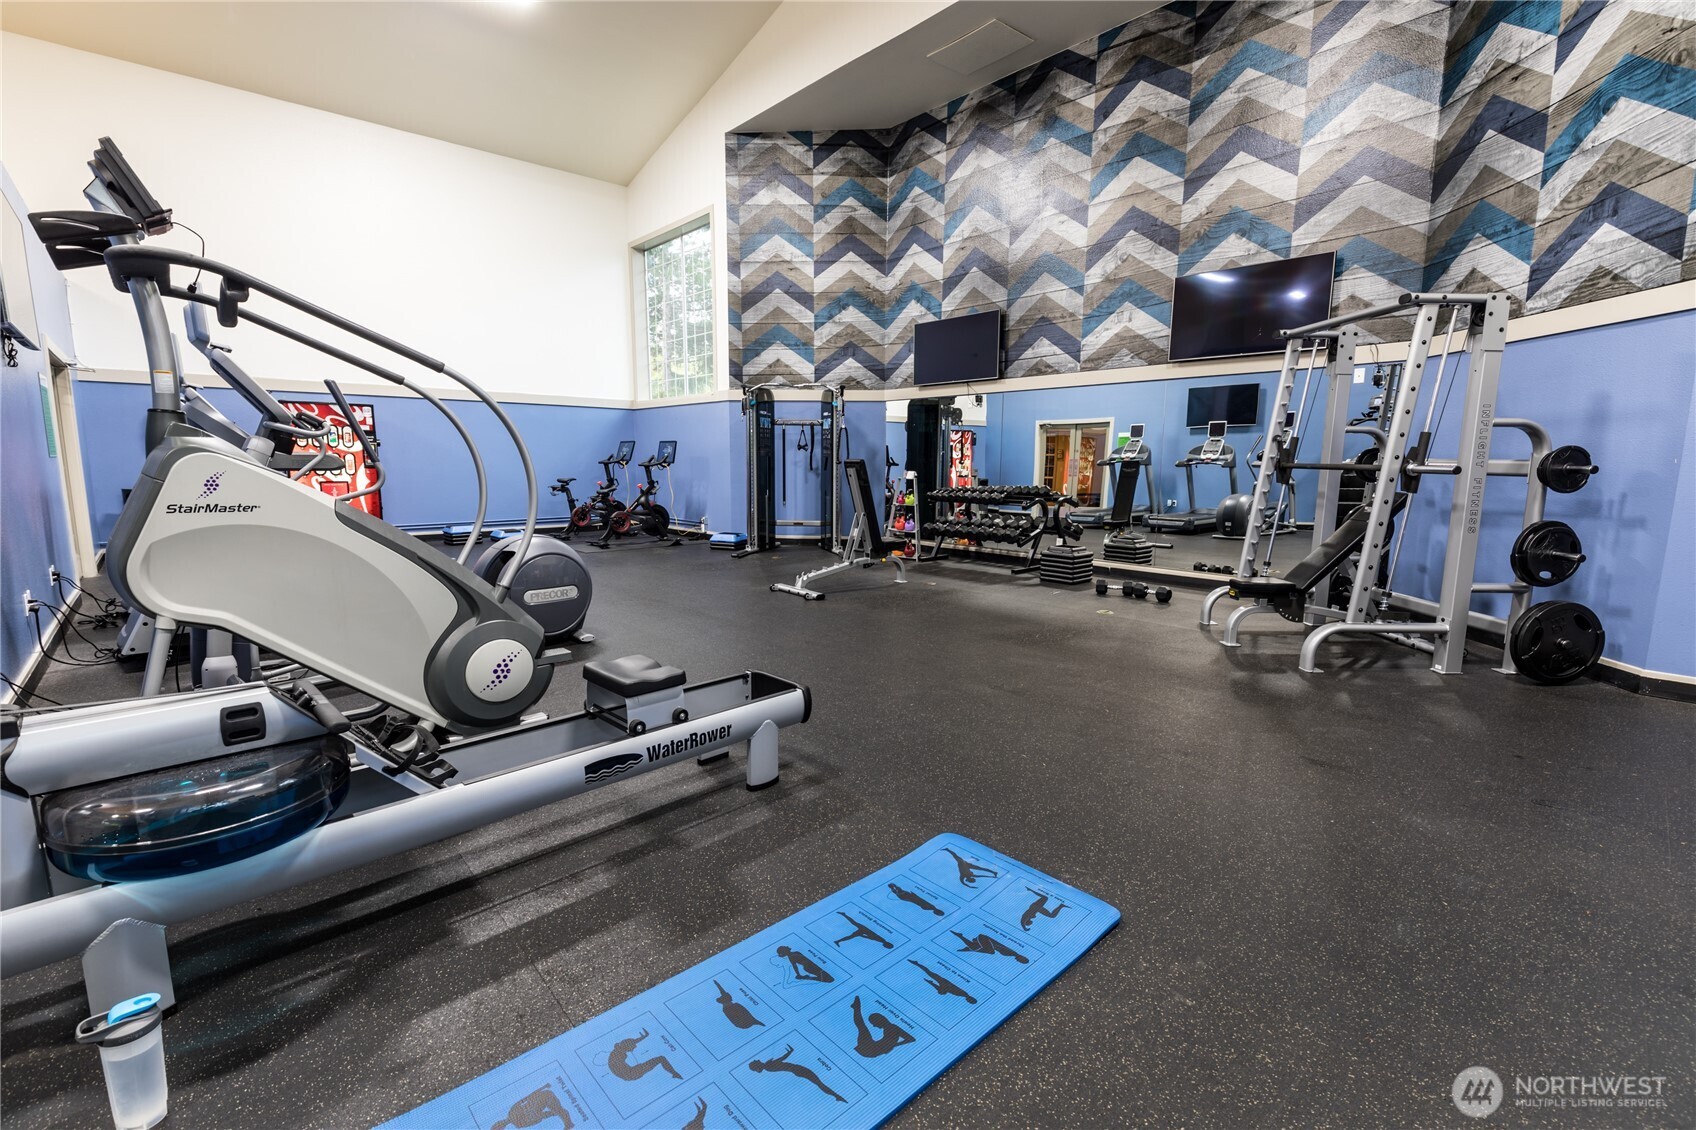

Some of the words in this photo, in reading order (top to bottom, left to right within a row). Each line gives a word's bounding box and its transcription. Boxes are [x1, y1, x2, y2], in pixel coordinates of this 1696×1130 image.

[1475, 404, 1491, 468] INFLIGHT
[166, 503, 258, 514] StairMaster
[1467, 478, 1482, 534] FITNESS
[530, 589, 569, 601] PRECOR
[646, 724, 732, 762] WaterRower
[817, 1057, 832, 1071] Cobra
